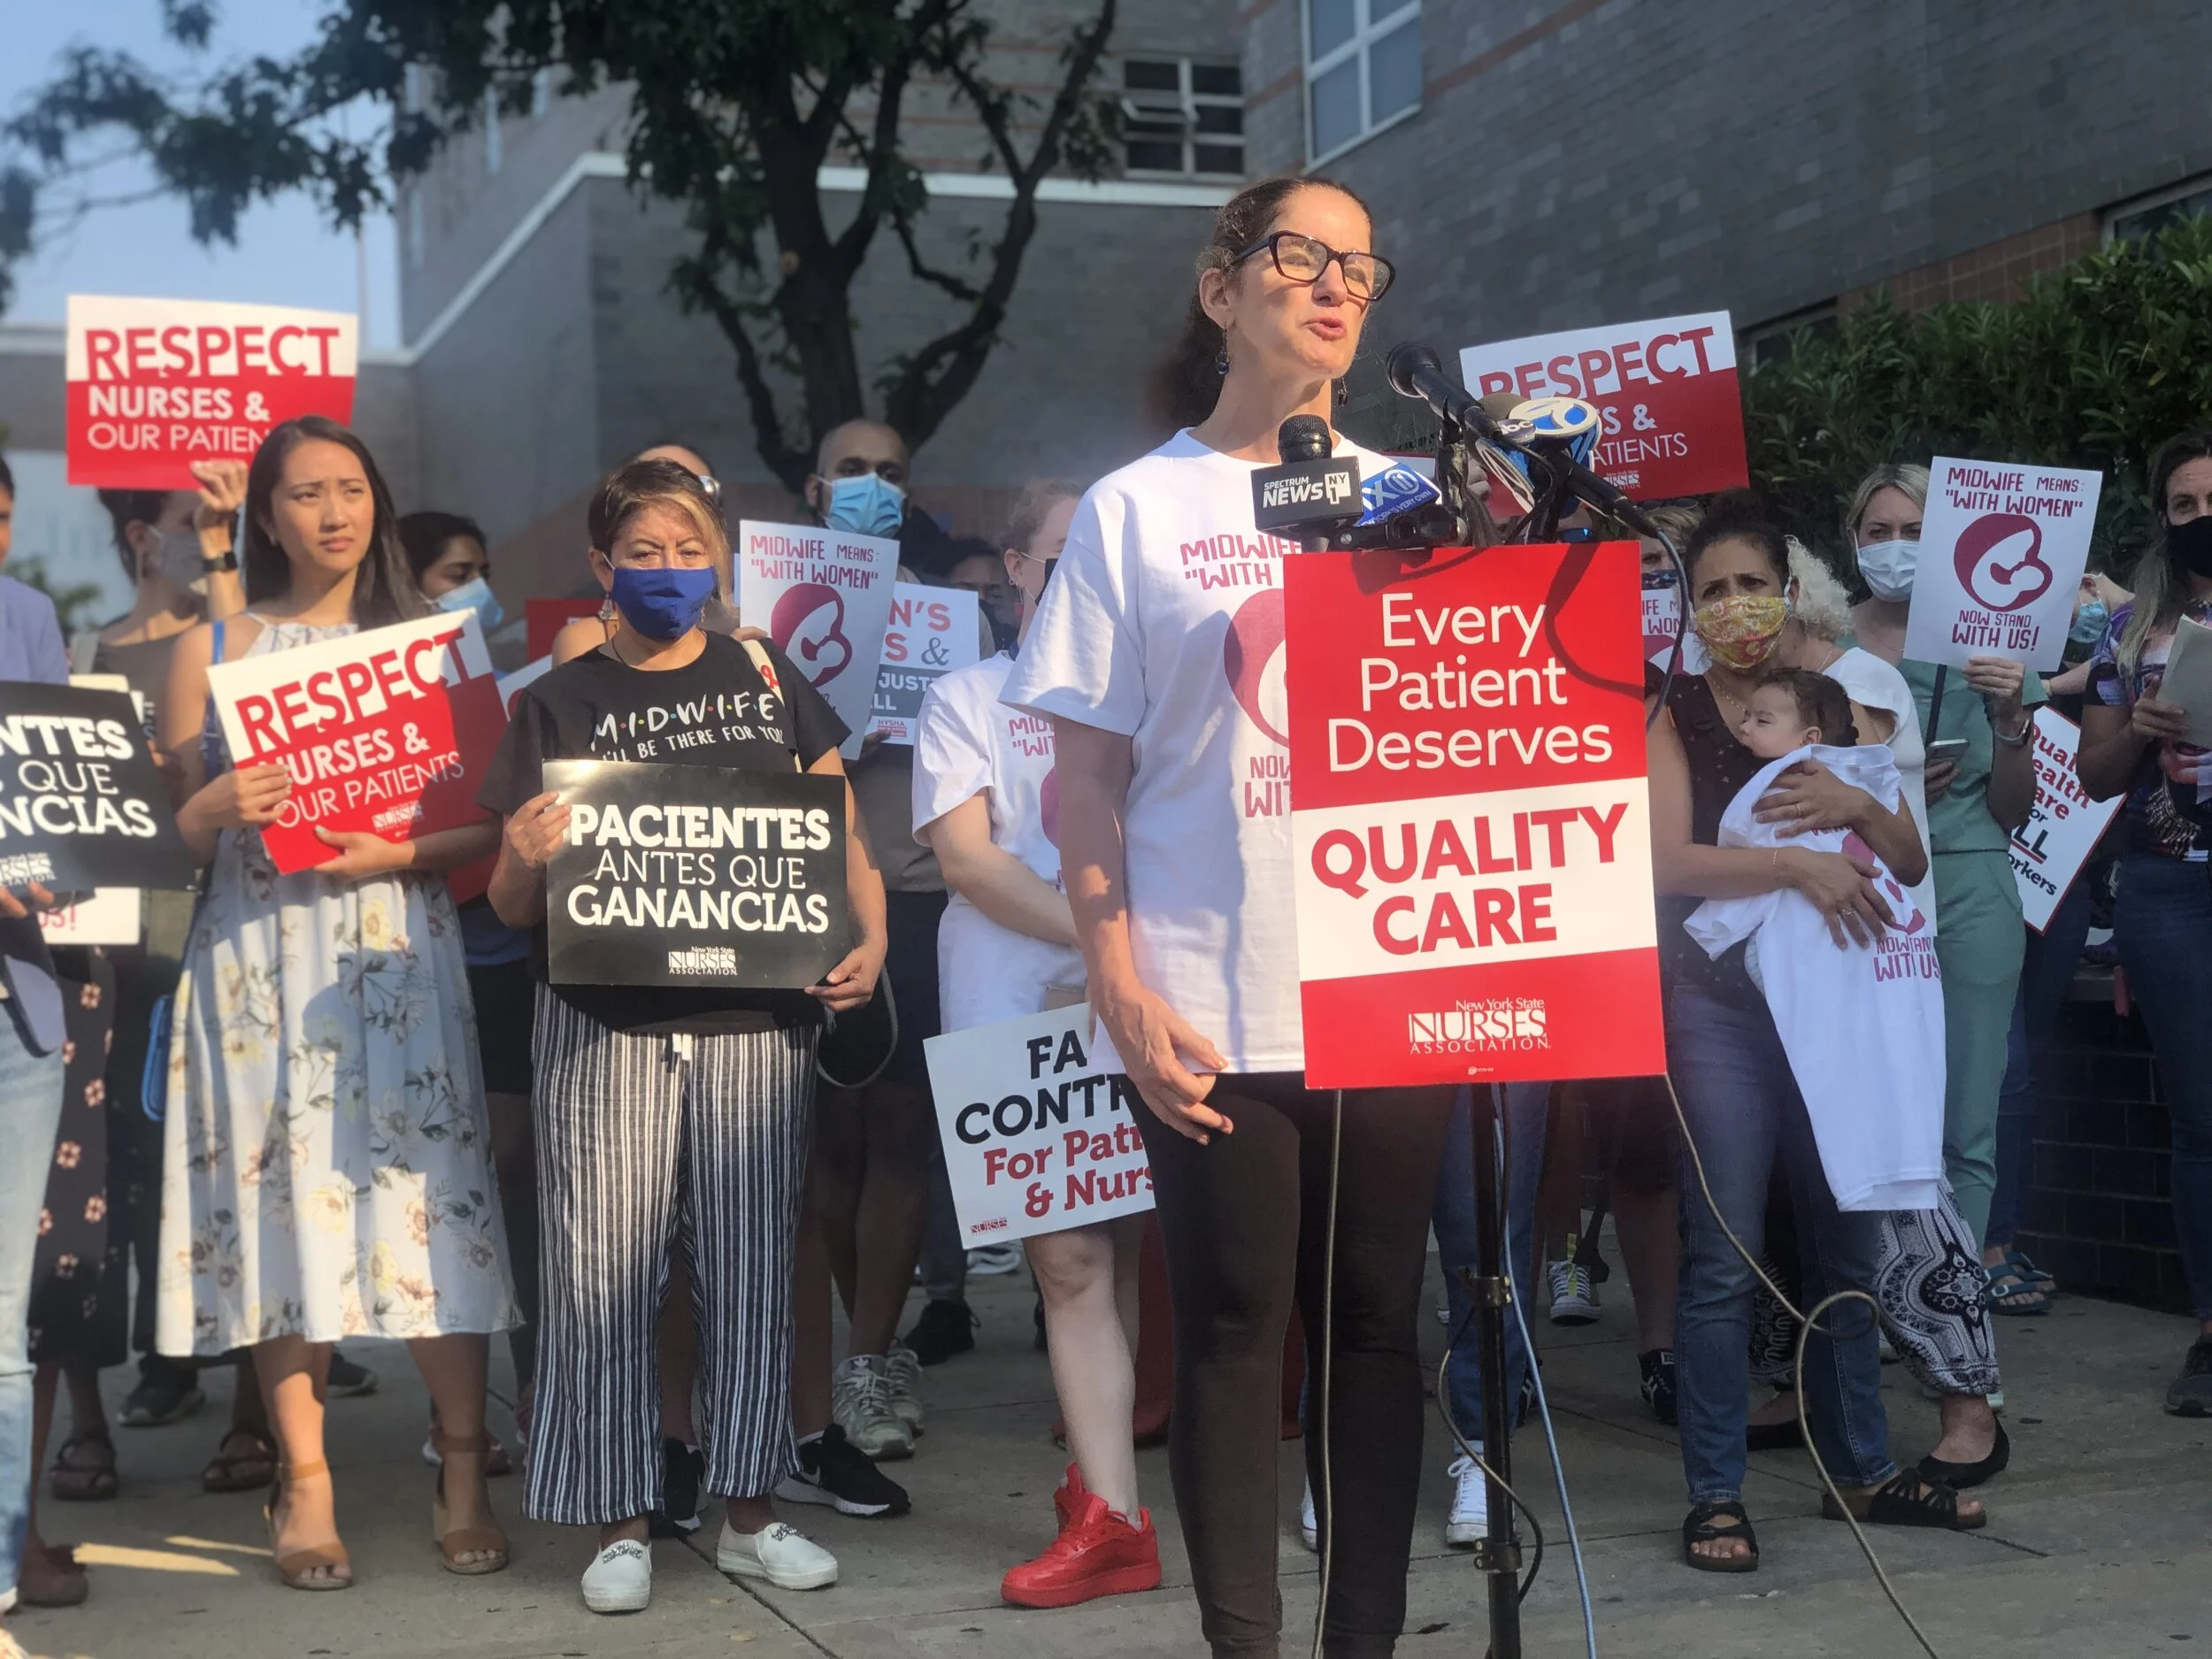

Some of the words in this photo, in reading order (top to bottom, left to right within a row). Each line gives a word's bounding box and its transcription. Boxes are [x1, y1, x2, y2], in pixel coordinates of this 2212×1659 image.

[85, 325, 340, 380] RESPECT
[1479, 326, 1715, 400] RESPECT
[88, 385, 234, 420] NURSES
[244, 391, 271, 422] &
[1632, 403, 1658, 431] &
[88, 421, 161, 451] OUR
[170, 424, 271, 453] PATIEN
[1593, 432, 1687, 466] ATIENTS
[1263, 475, 1310, 490] SPECTRUM
[1263, 482, 1324, 508] NEWS
[1328, 474, 1347, 485] NY
[1330, 487, 1338, 503] 1
[1947, 467, 2025, 493] MIDWIFE
[2036, 477, 2085, 493] MEANS:
[1397, 498, 1416, 511] VERY
[1415, 489, 1432, 502] OWN
[1945, 489, 2000, 512] "WITH
[2005, 495, 2084, 518] WOMEN"
[750, 534, 826, 561] MIDWIFE
[750, 558, 804, 582] "WITH
[810, 565, 879, 590] WOMEN"
[1381, 592, 1547, 658] Every
[1958, 610, 1991, 627] NOW
[1994, 612, 2032, 628] STAND
[921, 636, 950, 666] &
[1951, 624, 2000, 649] WITH
[2007, 626, 2039, 652] US!
[234, 626, 465, 757] RESPECT
[878, 672, 933, 692] JUST
[1360, 654, 1568, 712] Patient
[872, 693, 897, 710] LL
[258, 728, 395, 786] URSES
[403, 722, 431, 754] &
[637, 740, 658, 759] BE
[664, 729, 717, 750] THERE
[721, 726, 757, 741] FOR
[757, 725, 785, 744] YOU
[1327, 718, 1612, 772] Deserves
[18, 760, 119, 795] QUE
[273, 786, 340, 828] OUR
[343, 750, 465, 810] PATIENTS
[2032, 758, 2090, 810] ealth
[0, 795, 157, 839] NCIAS
[2030, 808, 2048, 823] or
[2035, 785, 2070, 820] are
[571, 804, 831, 850] PACIENTES
[2013, 819, 2049, 861] LL
[1311, 802, 1629, 900] QUALITY
[595, 849, 716, 886] ANTES
[729, 855, 806, 889] QUE
[2008, 853, 2057, 895] orkers
[567, 885, 829, 933] GANANCIAS
[1372, 882, 1557, 956] CARE
[669, 951, 736, 969] NURSES
[669, 966, 738, 975] ASSOCIATION
[1455, 1000, 1485, 1012] New
[1486, 997, 1514, 1011] York
[1516, 996, 1545, 1010] State
[1409, 1010, 1547, 1043] NURSES
[1026, 1029, 1088, 1080] FA
[1410, 1037, 1549, 1055] ASSOCIATION
[983, 1146, 1054, 1186] For
[1063, 1122, 1144, 1167] Pati
[1025, 1181, 1054, 1218] &
[1064, 1166, 1154, 1211] Nurs
